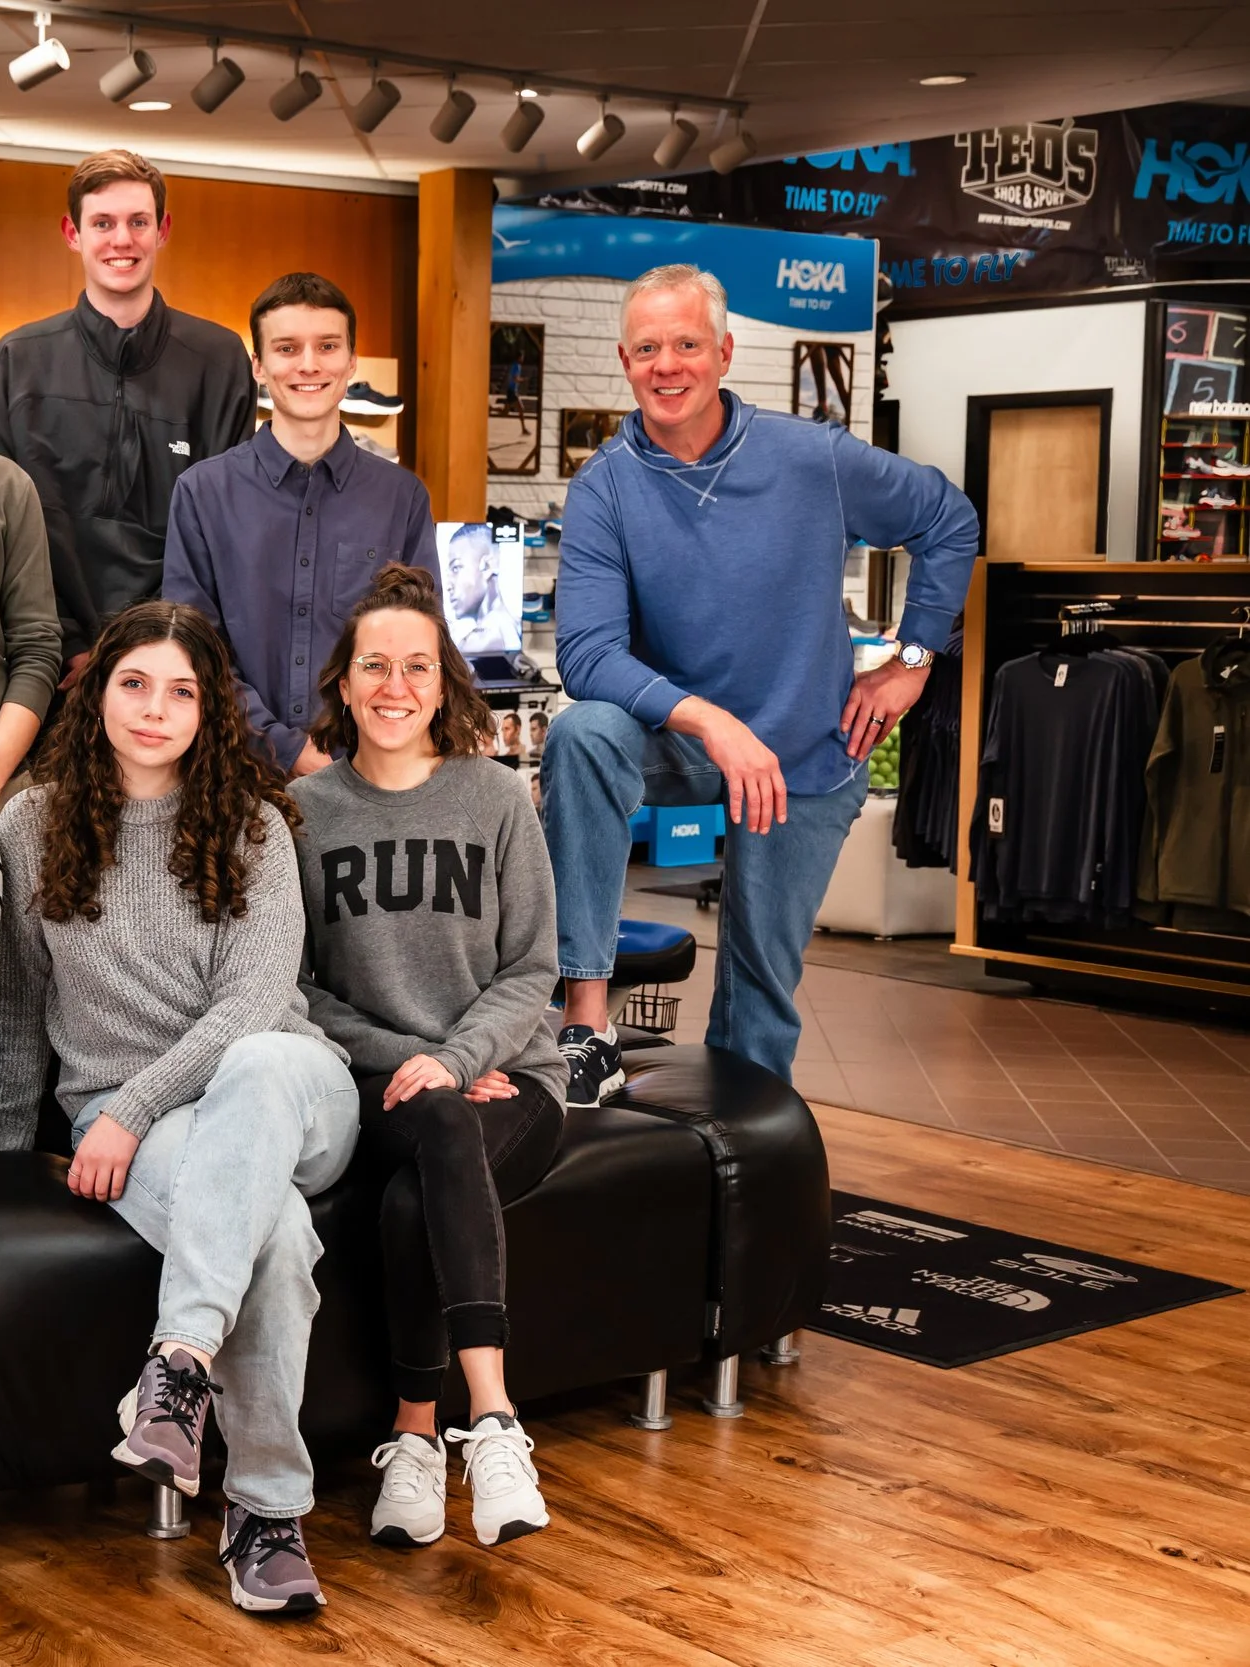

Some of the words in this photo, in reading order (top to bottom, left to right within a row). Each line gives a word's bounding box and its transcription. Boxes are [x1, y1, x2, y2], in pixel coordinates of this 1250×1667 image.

[1133, 138, 1250, 204] HOK
[784, 185, 828, 212] TIME
[830, 188, 855, 214] TO
[855, 191, 883, 217] FLY
[993, 185, 1021, 205] SHOE
[1023, 183, 1032, 209] &
[1033, 186, 1065, 208] SPORT
[1167, 219, 1207, 243] TIME
[1209, 222, 1234, 245] TO
[776, 258, 848, 293] HOKA
[932, 256, 969, 286] TO
[974, 252, 1021, 283] FLY
[1167, 320, 1188, 344] 6
[1193, 376, 1215, 402] 5
[321, 839, 485, 925] RUN
[913, 1268, 1007, 1296] NORTH
[970, 1276, 1023, 1293] THE
[990, 1258, 1115, 1291] SOLE
[820, 1303, 923, 1336] adidas
